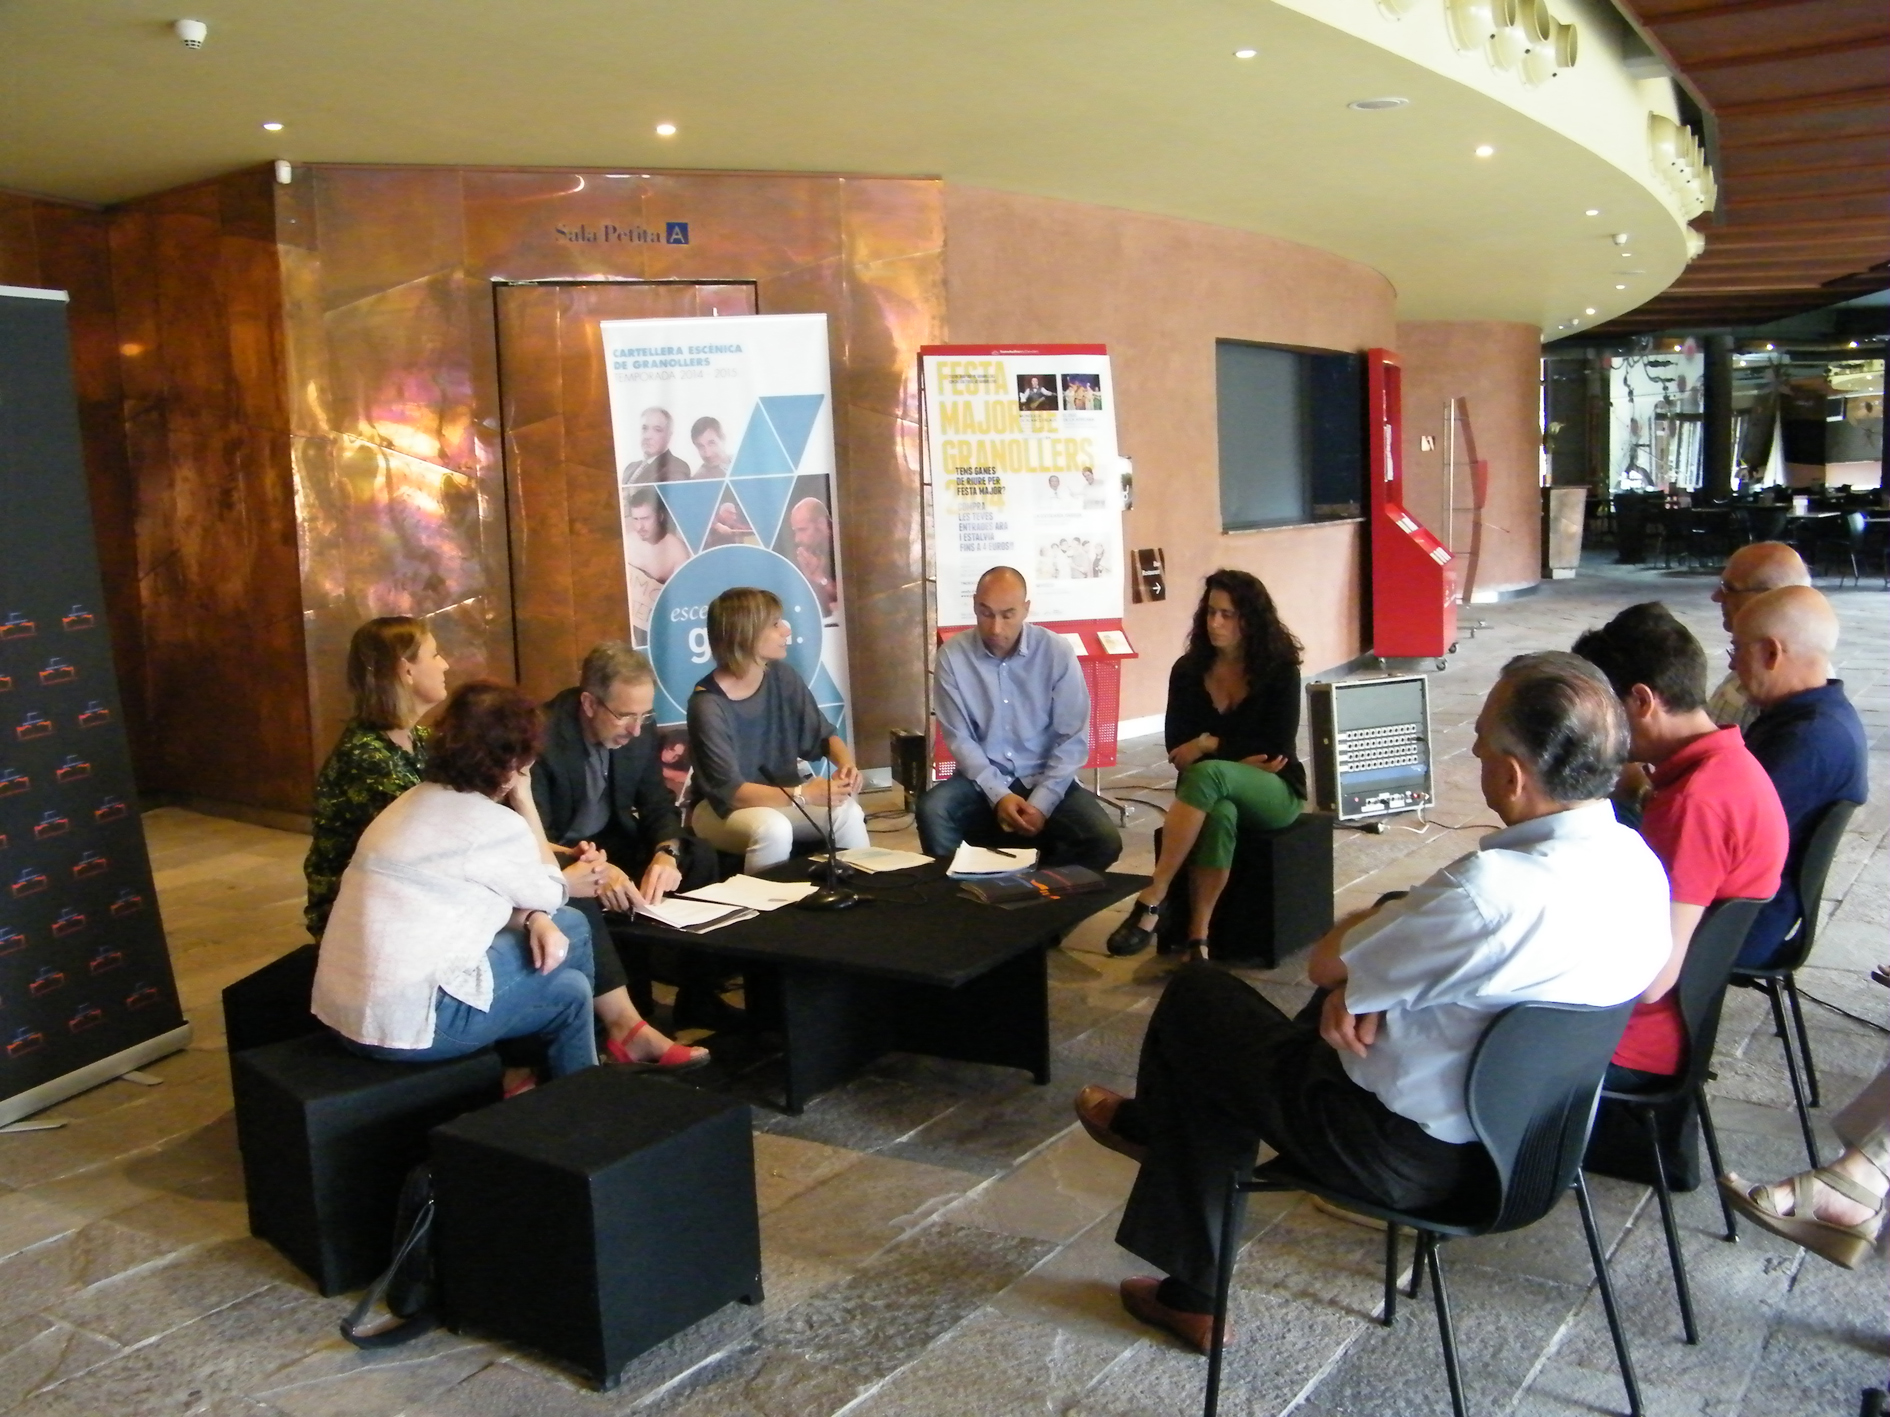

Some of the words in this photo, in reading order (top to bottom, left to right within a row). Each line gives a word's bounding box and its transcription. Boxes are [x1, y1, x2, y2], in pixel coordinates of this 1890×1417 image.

[555, 223, 597, 243] Sala
[604, 223, 661, 243] Petita
[668, 224, 687, 243] A
[612, 346, 684, 359] CARTELLERA
[613, 360, 628, 370] DE
[632, 357, 711, 370] GRANOLLERS
[615, 370, 676, 383] TEMPORADA
[936, 360, 1009, 396] FESTA
[939, 400, 1024, 436] MAJOR
[941, 437, 1096, 476] GRANOLLERS
[955, 467, 973, 476] TENS
[974, 466, 996, 476] GANES
[956, 477, 965, 486] DE
[988, 476, 1001, 485] PER
[957, 487, 978, 496] FESTA
